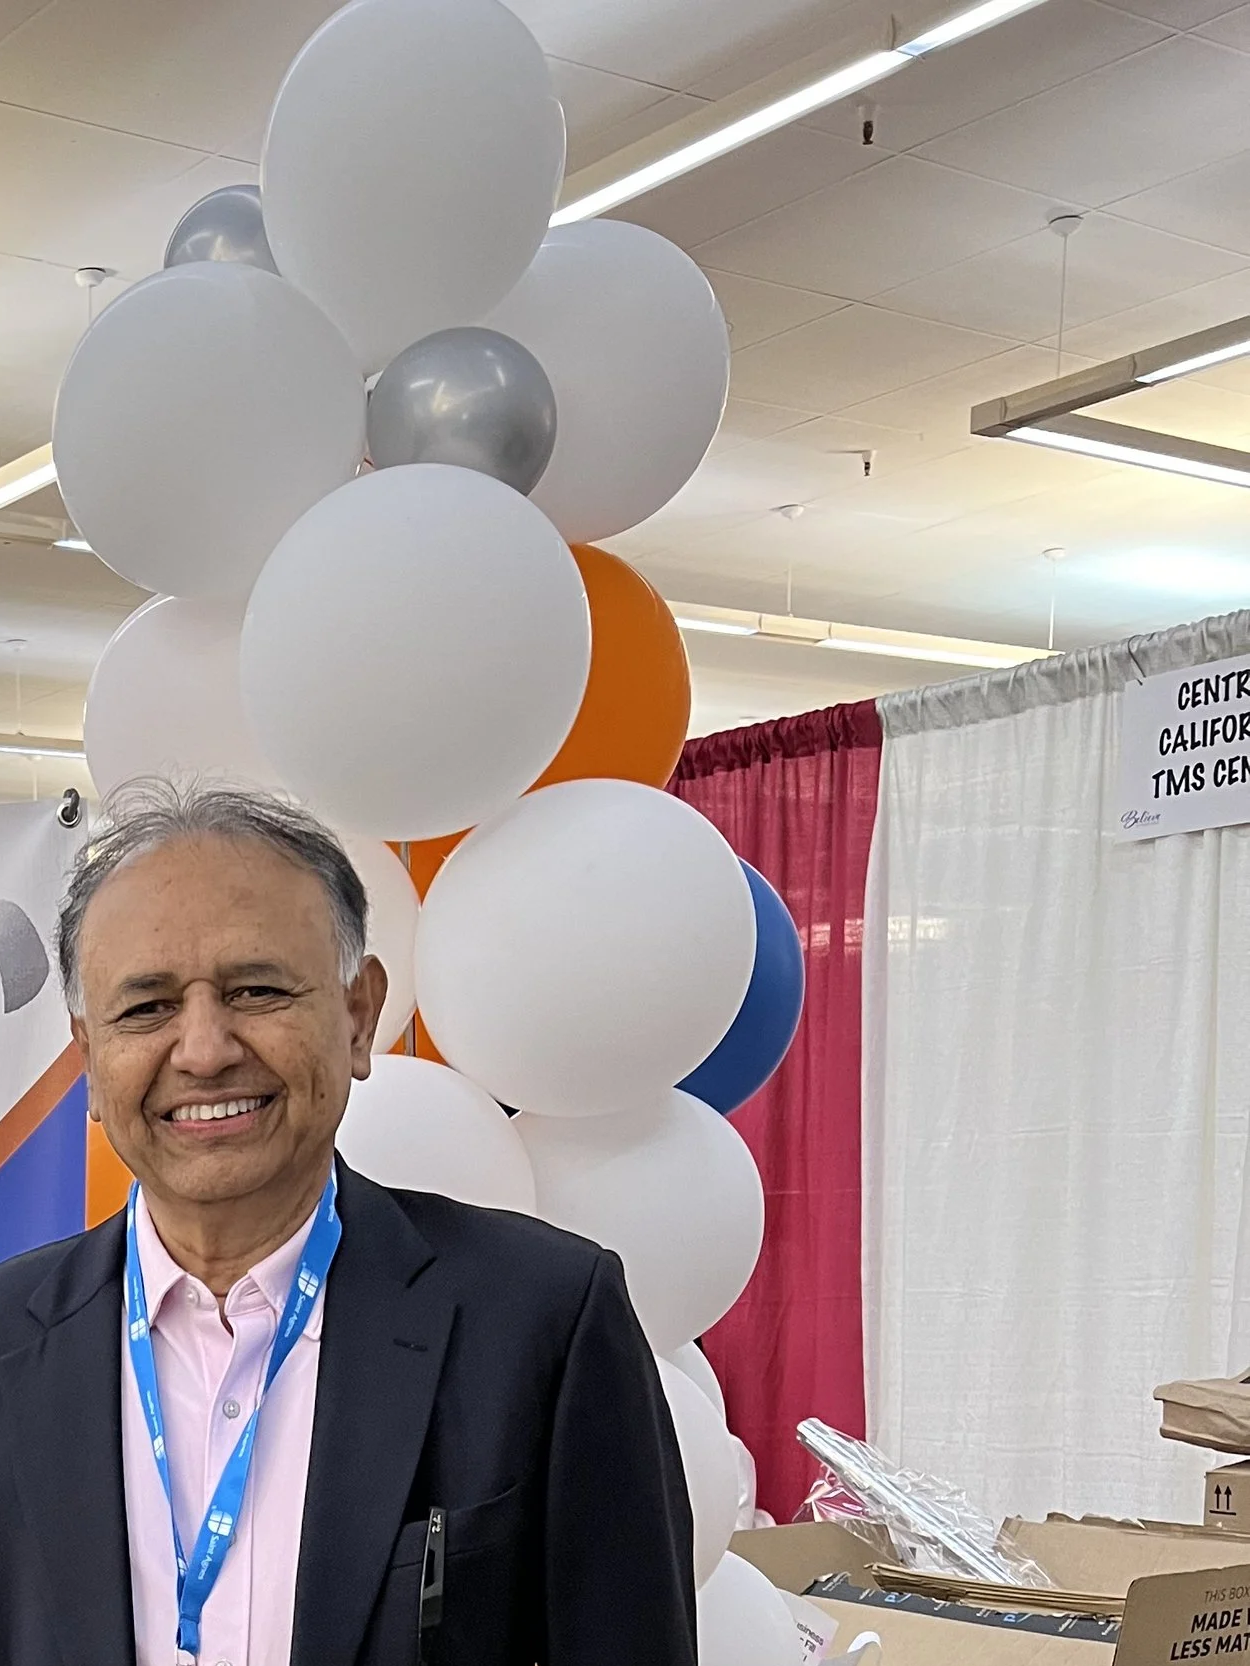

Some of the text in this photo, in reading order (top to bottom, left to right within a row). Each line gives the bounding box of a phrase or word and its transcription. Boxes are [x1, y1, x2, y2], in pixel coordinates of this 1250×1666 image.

[1178, 668, 1250, 710] CENTR
[1159, 712, 1250, 756] CALIFOR
[1152, 756, 1250, 799] TMS CEN
[1205, 1586, 1250, 1604] THIS BOX
[1191, 1609, 1243, 1633] MADE
[1170, 1633, 1250, 1660] LESS MAT
